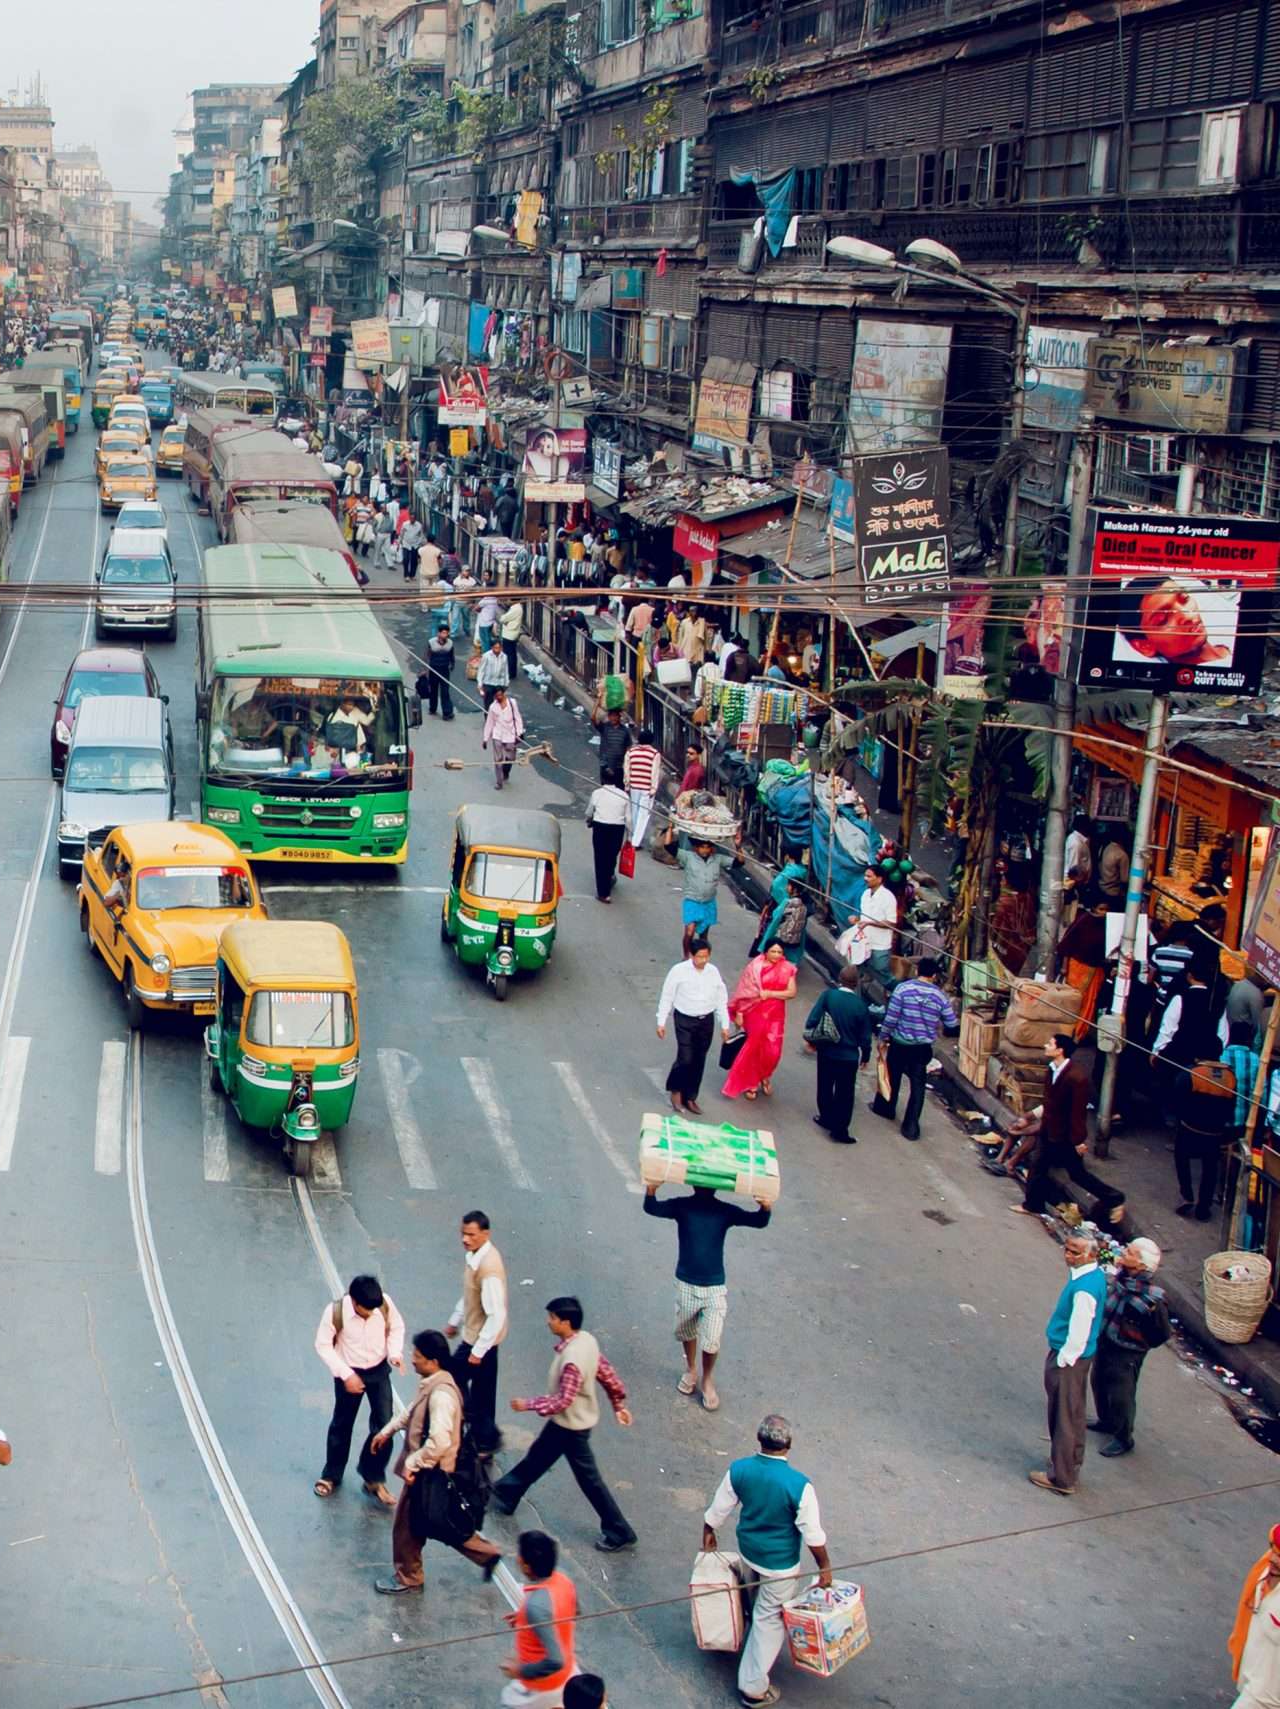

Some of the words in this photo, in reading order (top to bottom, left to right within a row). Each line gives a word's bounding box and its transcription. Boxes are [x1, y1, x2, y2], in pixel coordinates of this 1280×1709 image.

[1133, 357, 1183, 372] rompton
[1104, 521, 1139, 532] Mukesh
[1141, 523, 1175, 534] Harane
[1177, 526, 1212, 537] 24-year
[1214, 527, 1230, 537] old
[1102, 538, 1137, 553] Died
[1164, 540, 1197, 557] Oral
[1200, 543, 1257, 561] Cancer
[869, 541, 944, 580] Mala
[1194, 676, 1215, 686] QUIT
[1216, 677, 1245, 687] TODAY
